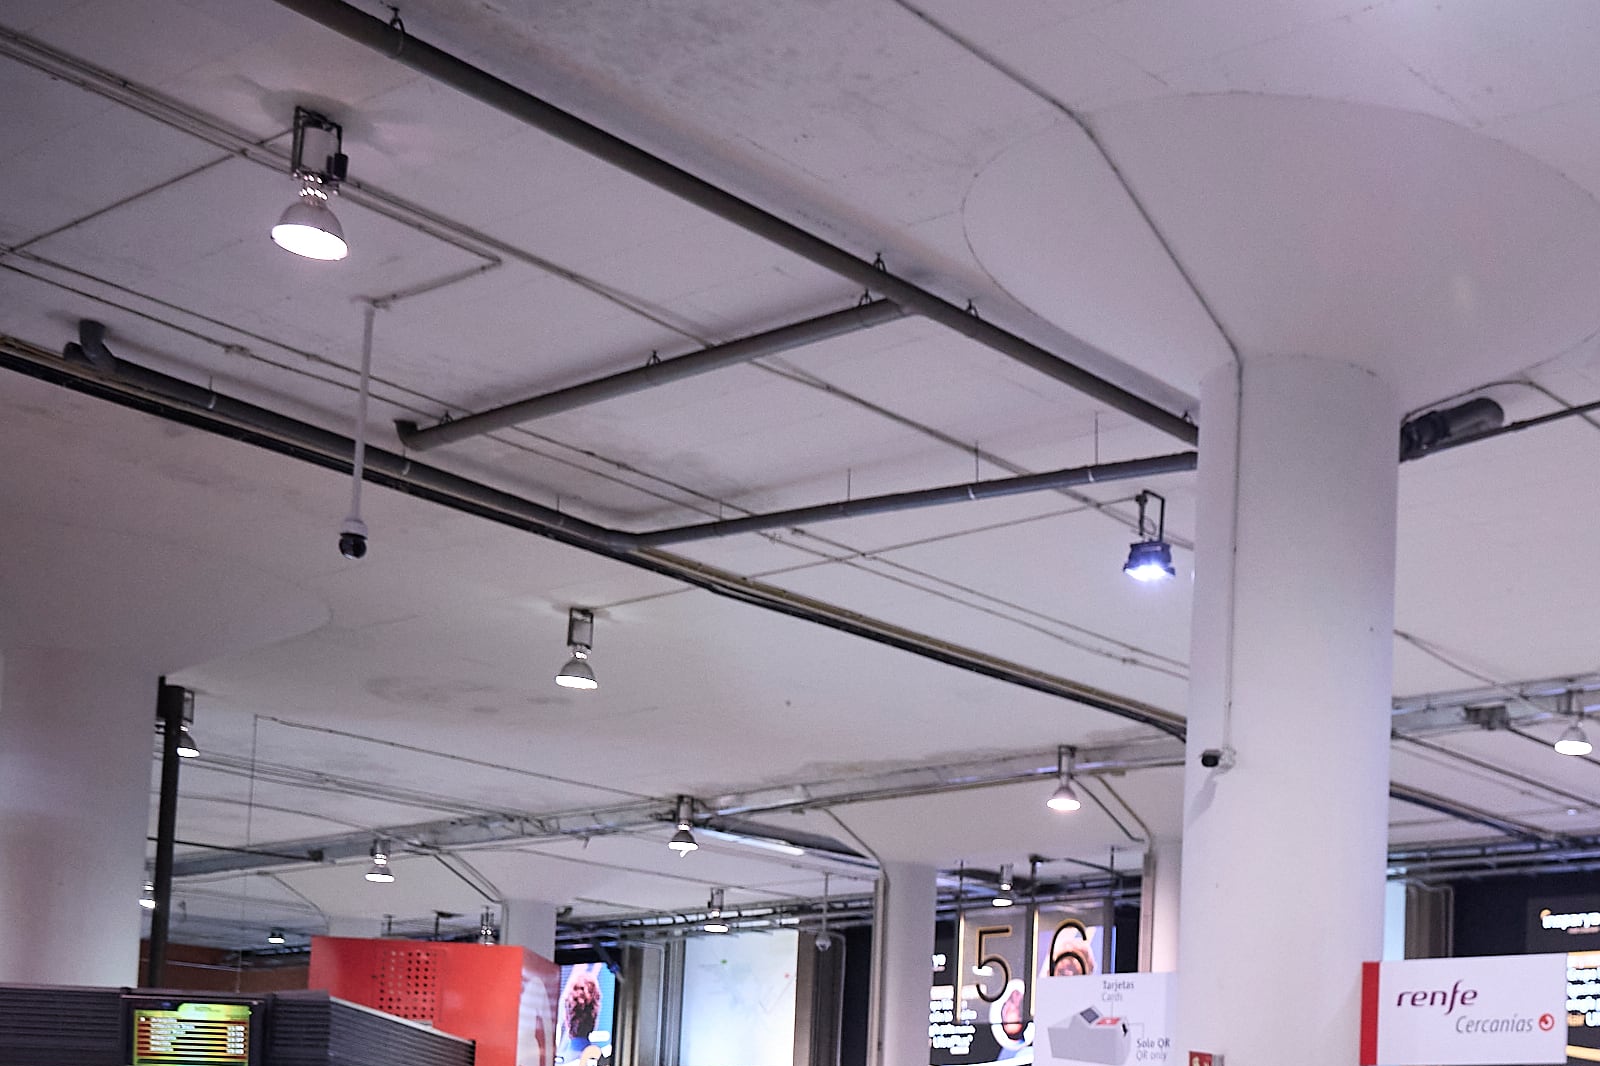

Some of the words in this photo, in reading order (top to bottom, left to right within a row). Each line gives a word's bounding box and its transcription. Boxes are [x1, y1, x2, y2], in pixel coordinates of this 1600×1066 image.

[976, 926, 1012, 1003] 5
[1102, 980, 1135, 992] Tarjetas
[1396, 980, 1478, 1015] renfe
[1455, 1013, 1534, 1034] Cercanías
[1136, 1039, 1154, 1050] Solo
[1156, 1039, 1171, 1051] QR
